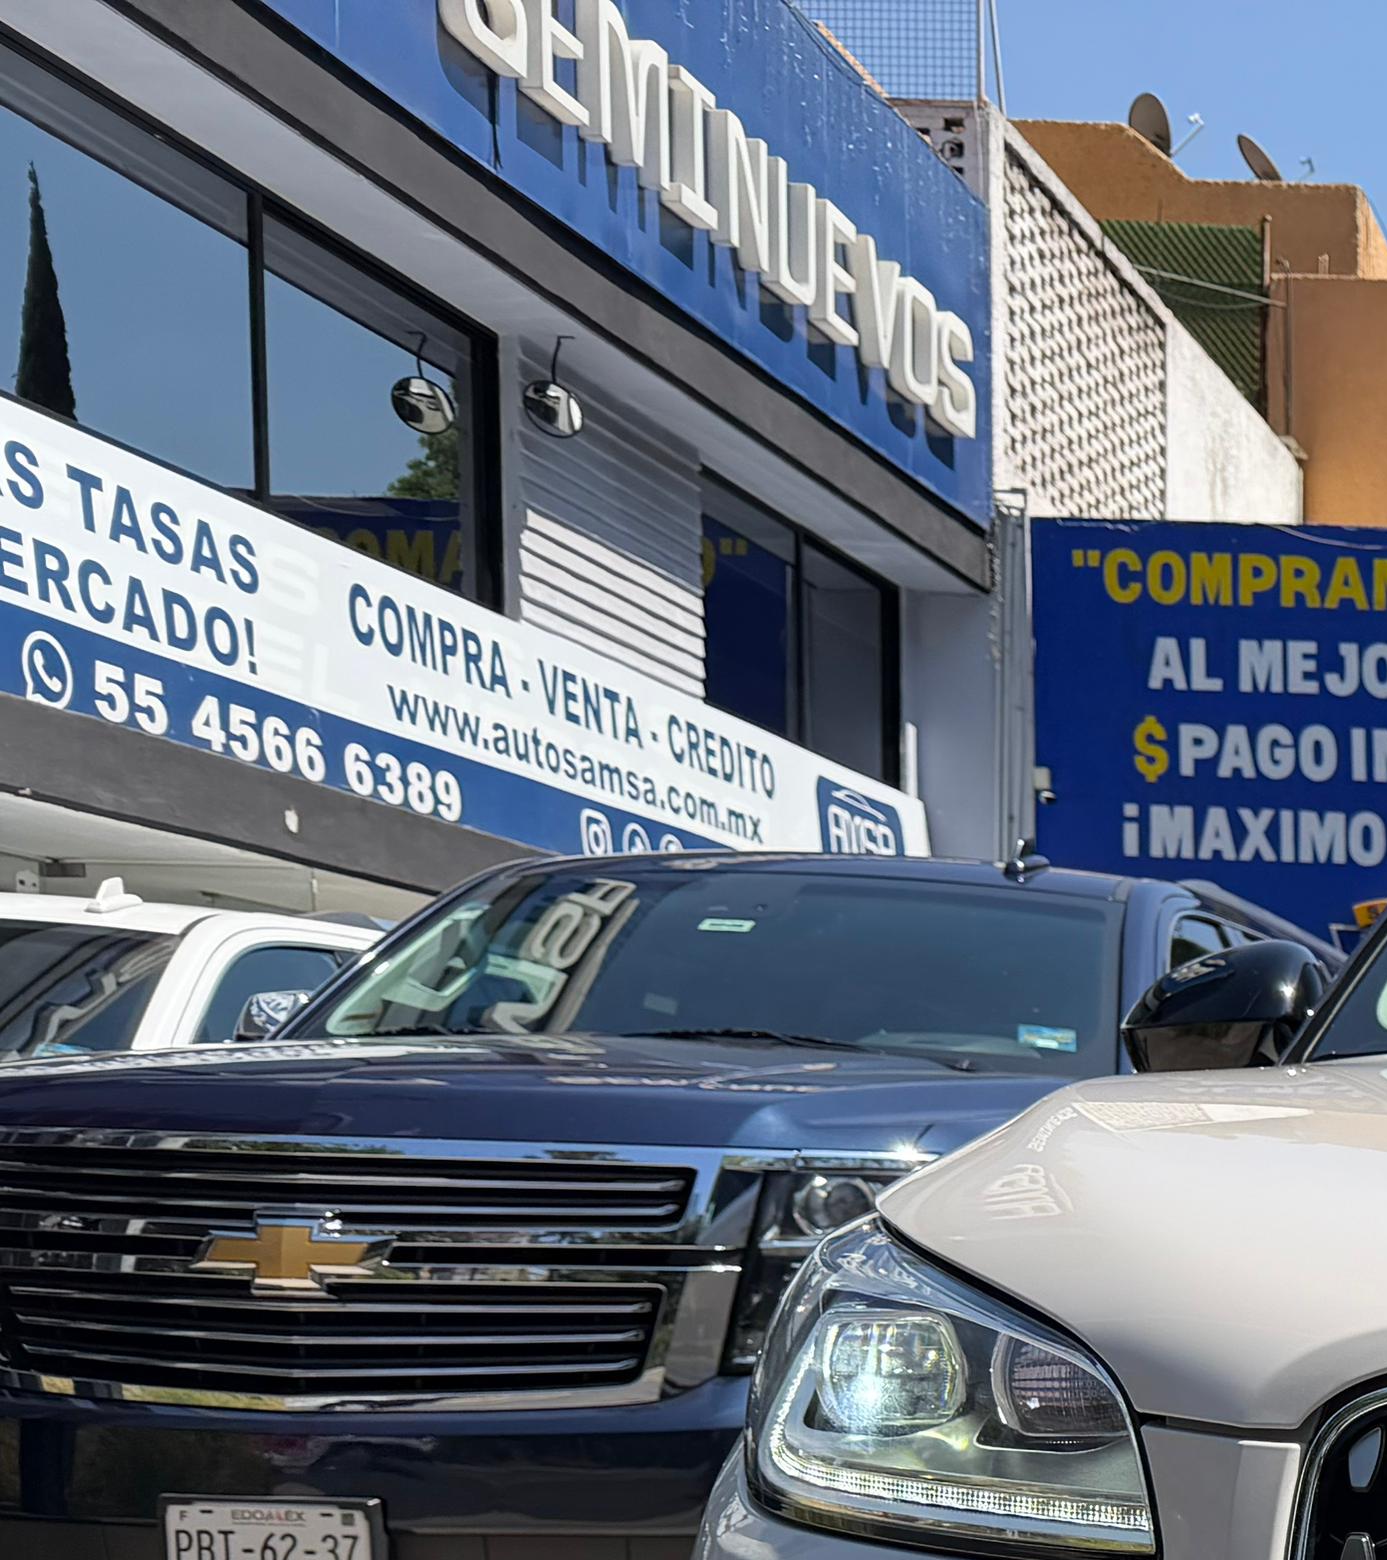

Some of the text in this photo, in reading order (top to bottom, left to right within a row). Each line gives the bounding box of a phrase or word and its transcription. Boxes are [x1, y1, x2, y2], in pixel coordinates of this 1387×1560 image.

[0, 440, 44, 510] S
[66, 464, 260, 595] TASAS
[94, 660, 169, 736] 55
[191, 695, 327, 783] 4566
[343, 743, 464, 822] 6389
[348, 583, 513, 700] COMPRA
[538, 659, 643, 749] VENTA
[666, 714, 777, 800] CREDITO
[1148, 637, 1223, 692] AL
[386, 684, 764, 845] www.autosamsa.com.mx
